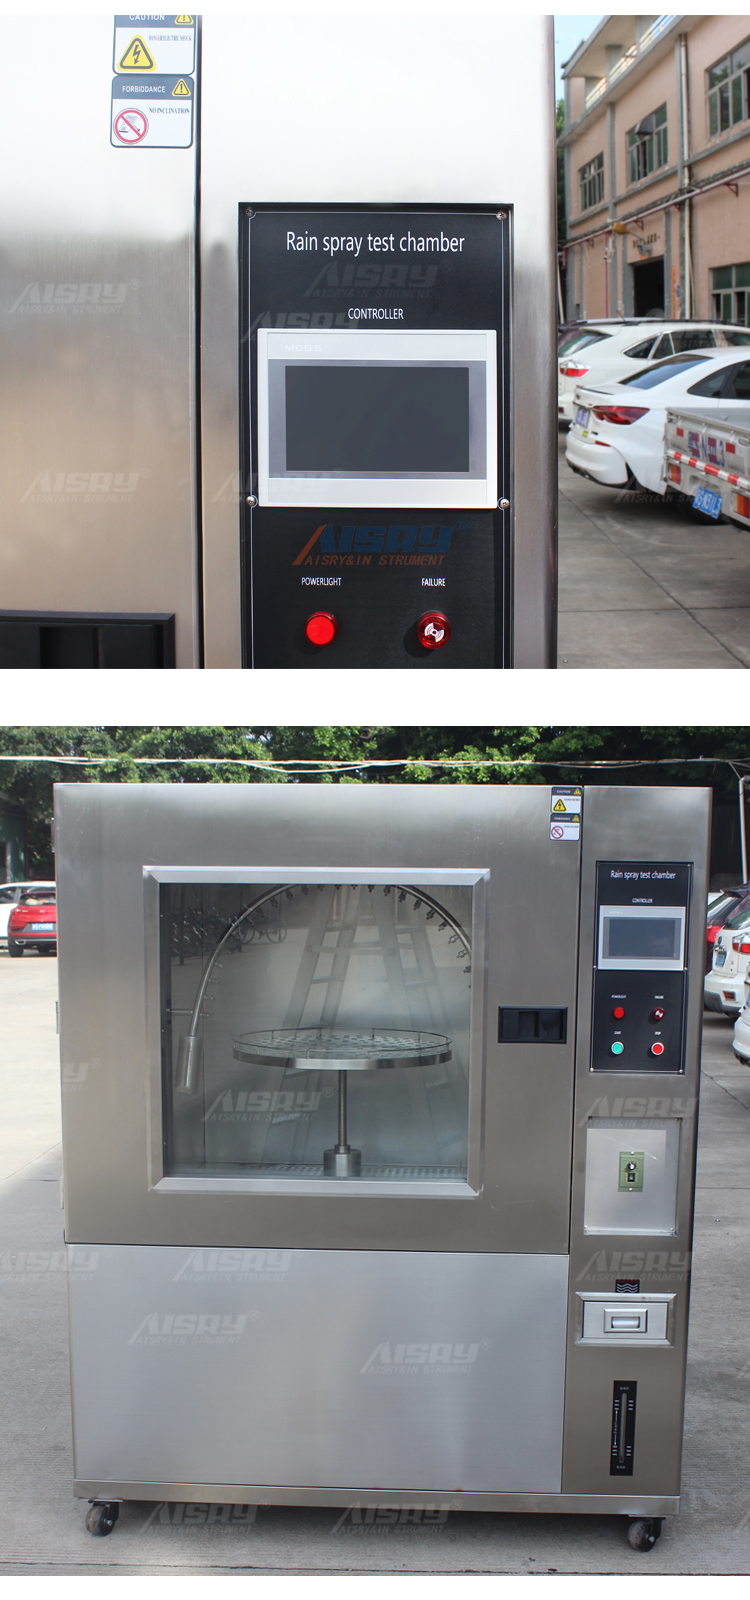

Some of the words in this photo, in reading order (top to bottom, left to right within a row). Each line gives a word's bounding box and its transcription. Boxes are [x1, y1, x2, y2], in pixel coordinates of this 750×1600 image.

[122, 85, 166, 93] FORBIDDANCE
[286, 231, 318, 252] Rain
[322, 236, 363, 257] spray
[367, 233, 395, 253] test
[399, 231, 466, 253] chamber
[347, 307, 404, 320] CONTROLLER
[285, 344, 321, 352] MCGS
[301, 577, 342, 586] POWERLIGHT
[421, 578, 446, 587] FAILURE
[610, 869, 623, 879] Rain
[624, 871, 640, 881] spray
[640, 871, 651, 879] test
[651, 871, 677, 880] chamber
